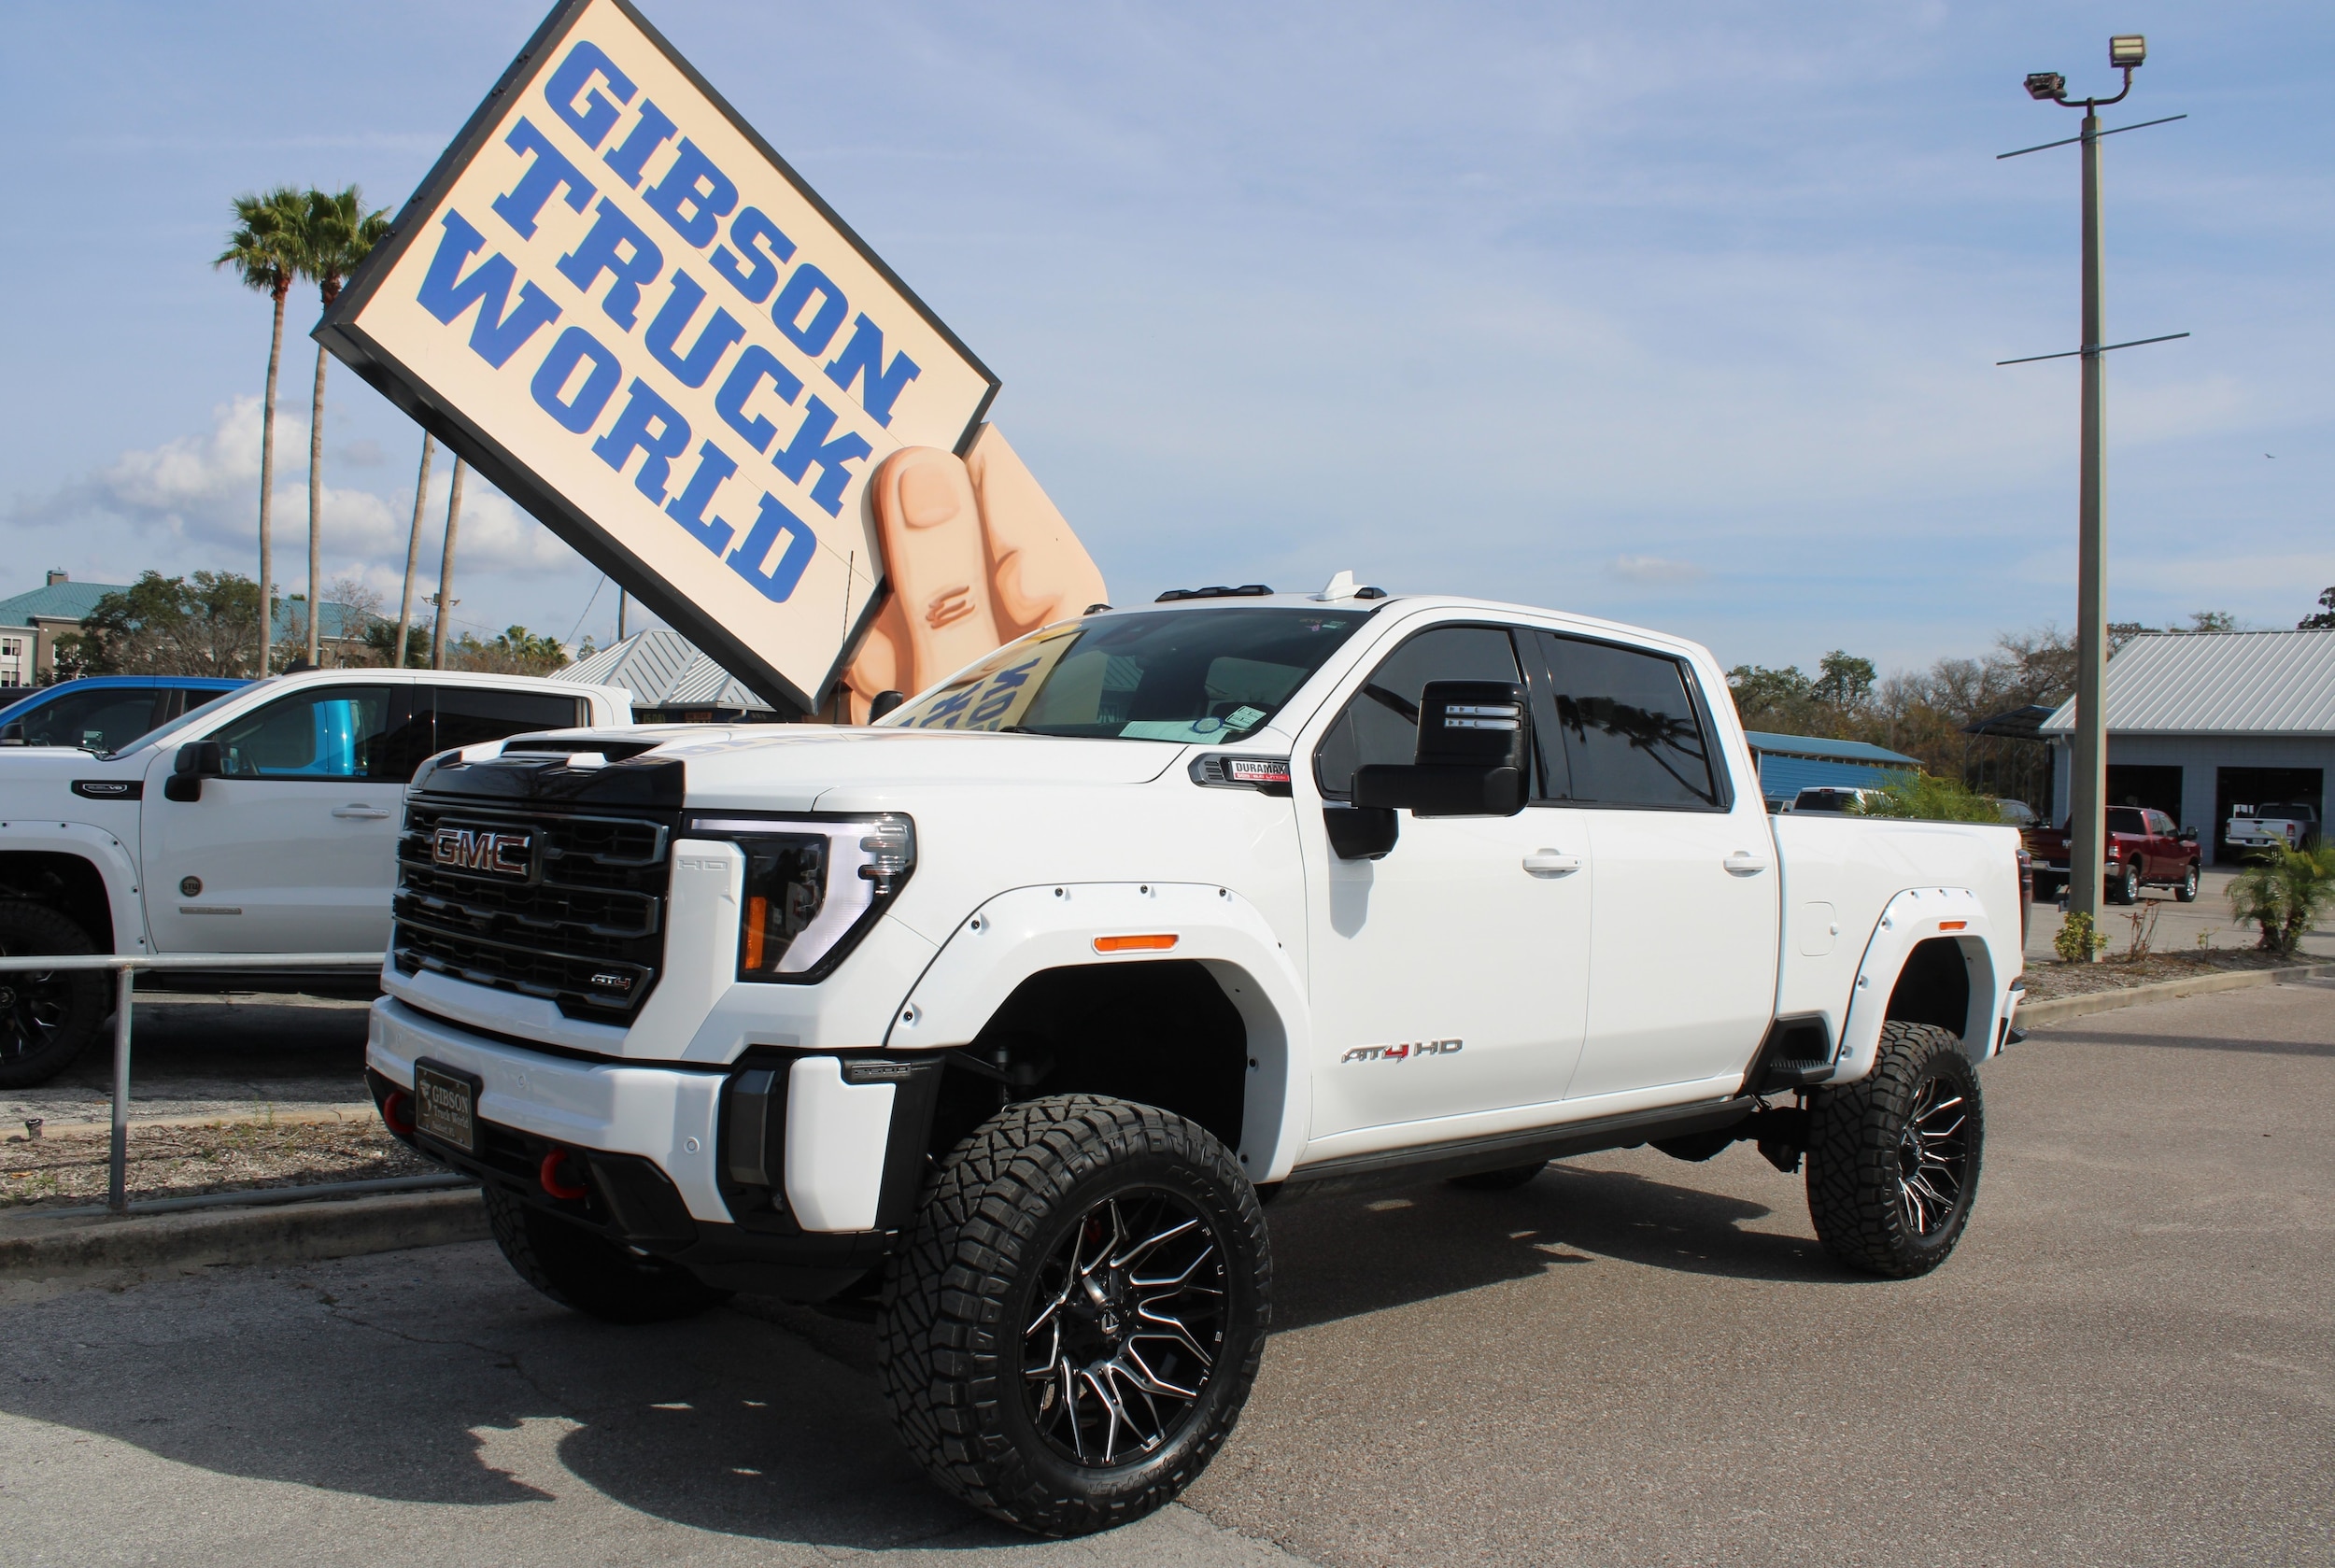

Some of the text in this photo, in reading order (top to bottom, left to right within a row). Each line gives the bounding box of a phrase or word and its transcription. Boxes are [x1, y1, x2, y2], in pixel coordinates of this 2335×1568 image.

[545, 40, 922, 429] GIBSON
[491, 116, 873, 519] TRUCK
[417, 208, 817, 603] WORLD
[1235, 762, 1286, 774] DURAMAX
[432, 827, 531, 876] GMC
[677, 859, 729, 870] HD
[591, 974, 631, 990] AT4
[1341, 1037, 1464, 1064] AT4 HD
[432, 1084, 469, 1114] GIBSON
[432, 1105, 450, 1122] Truck
[451, 1111, 469, 1129] World
